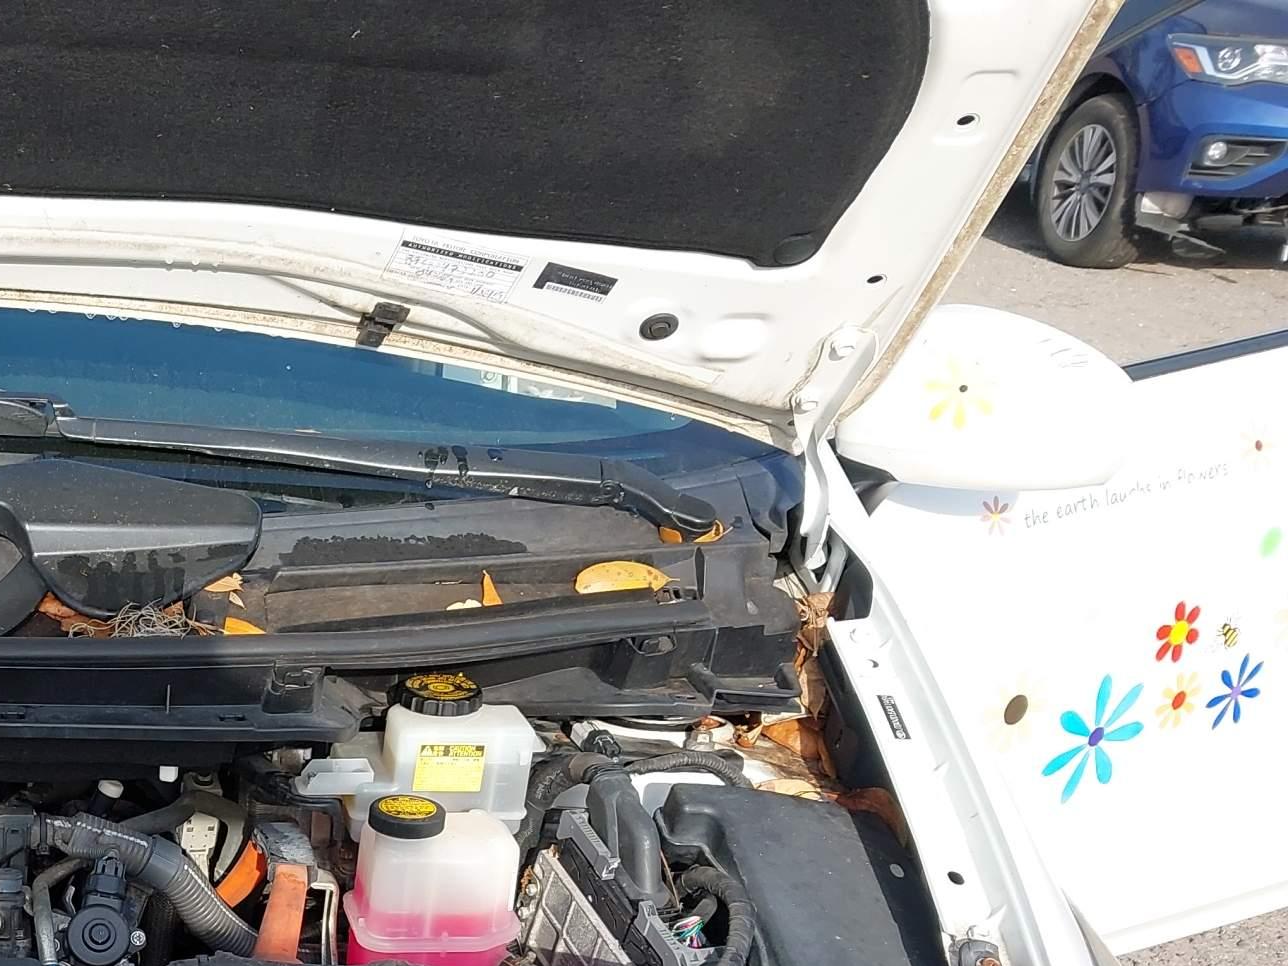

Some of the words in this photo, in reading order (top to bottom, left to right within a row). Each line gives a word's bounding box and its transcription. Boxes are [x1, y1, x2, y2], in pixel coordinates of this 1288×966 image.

[408, 242, 455, 257] AUTHORIZED
[457, 253, 518, 271] MODIFICATIONS
[1024, 508, 1050, 529] the
[1056, 492, 1099, 519] earth
[1158, 474, 1173, 491] in
